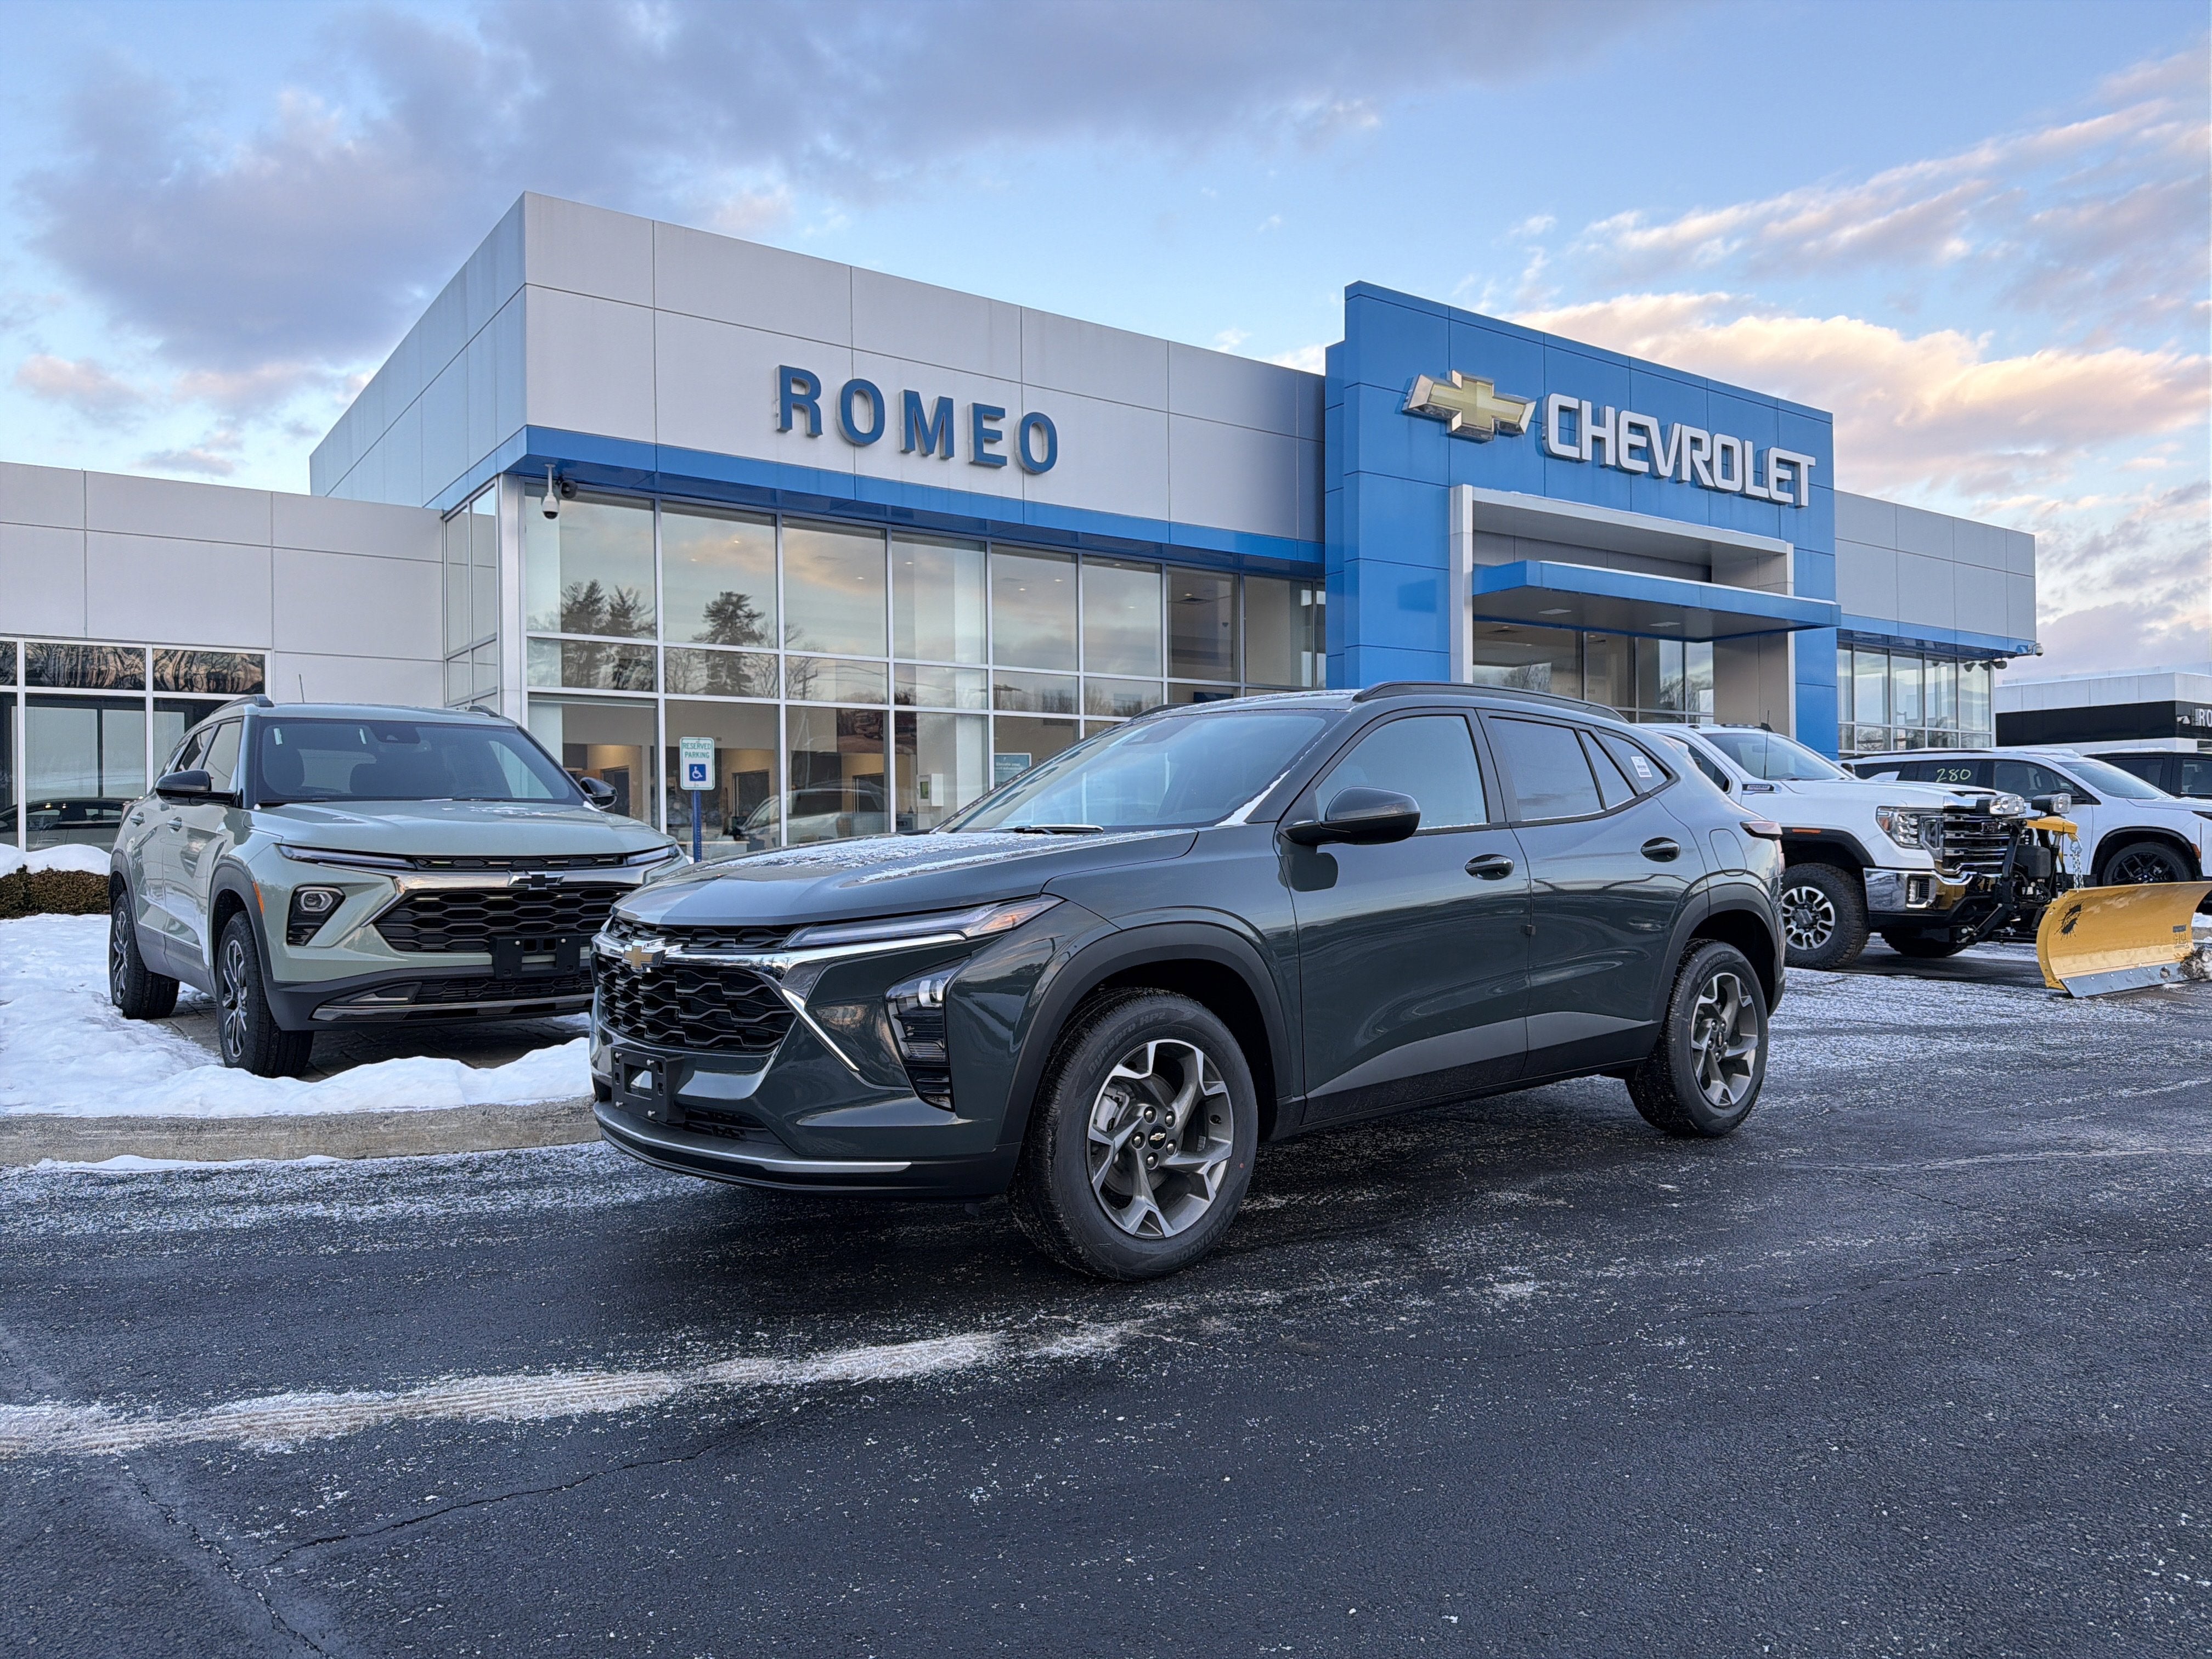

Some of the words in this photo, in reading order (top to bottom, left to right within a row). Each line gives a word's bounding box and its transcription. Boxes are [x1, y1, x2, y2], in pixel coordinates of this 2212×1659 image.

[774, 364, 1058, 474] ROMEO
[1543, 393, 1816, 507] CHEVROLET
[1936, 768, 1971, 782] 280
